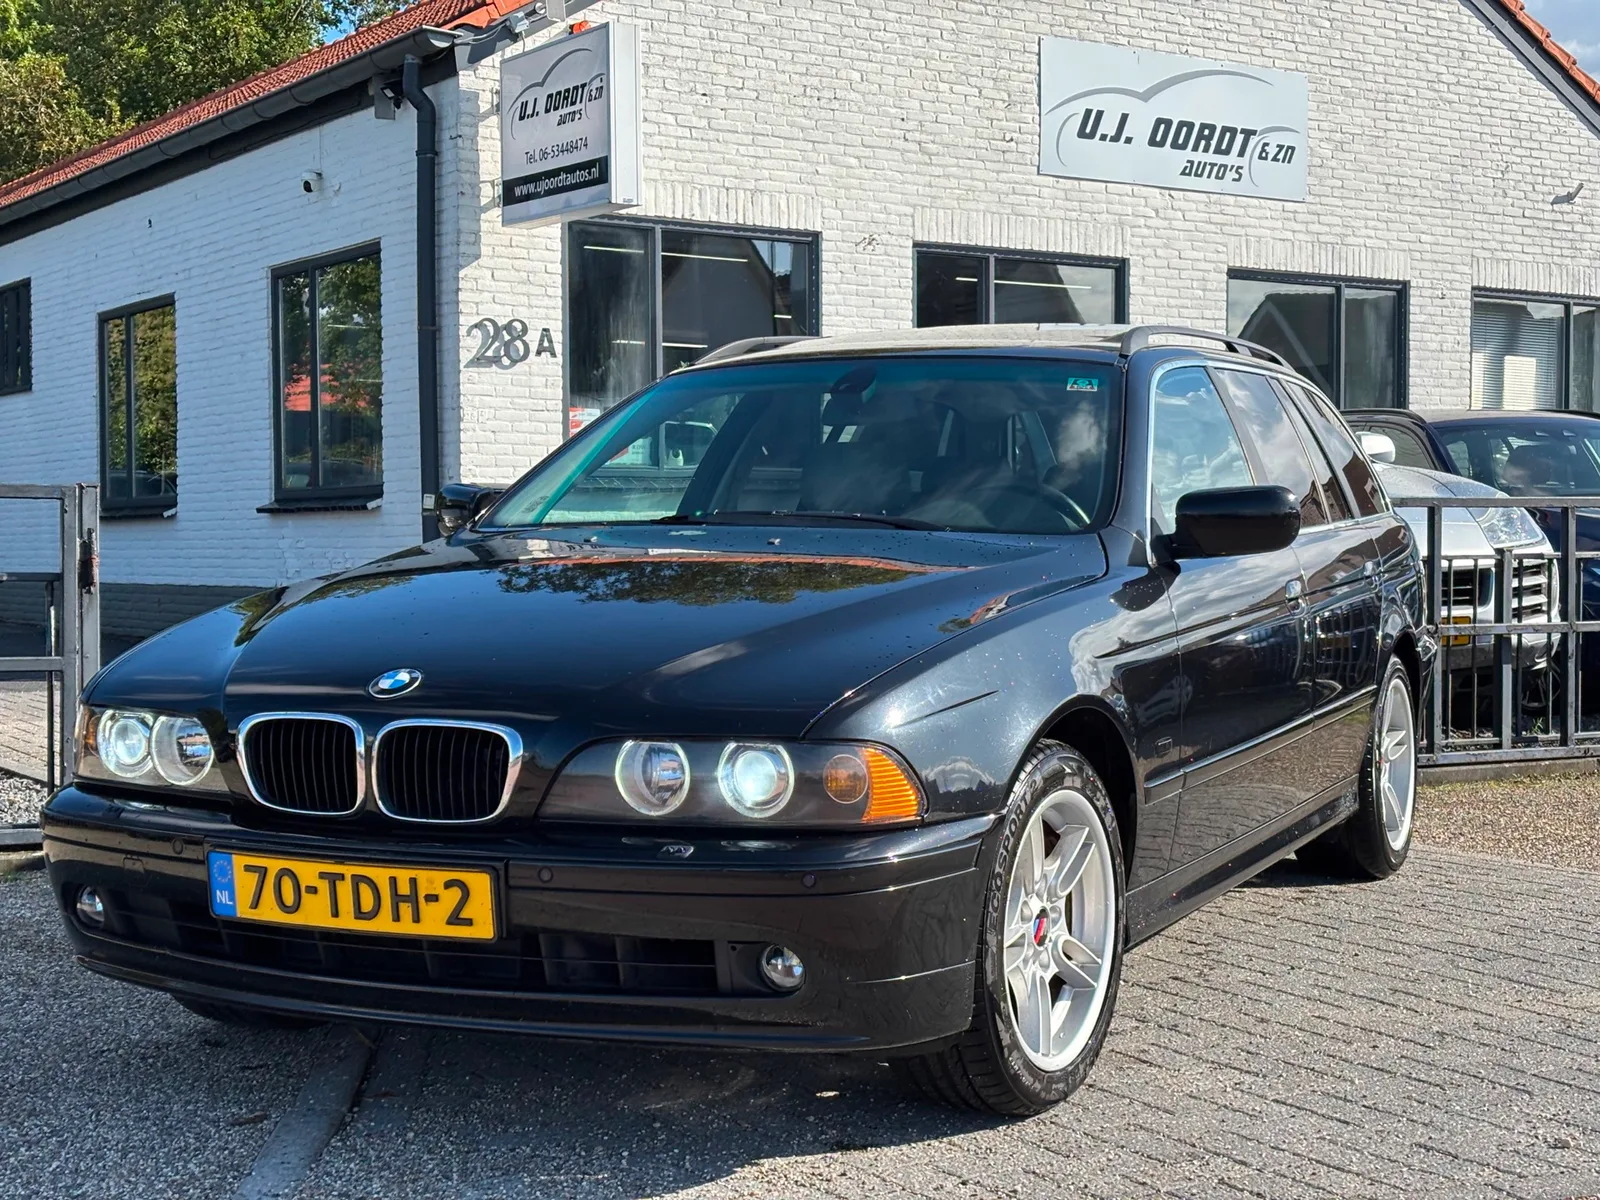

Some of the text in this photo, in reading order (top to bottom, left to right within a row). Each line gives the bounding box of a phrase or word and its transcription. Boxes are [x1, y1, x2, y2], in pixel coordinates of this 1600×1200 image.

[518, 97, 539, 121] U.J.
[544, 82, 588, 114] OORDT
[525, 136, 588, 165] Tel. 06-53448474
[1076, 108, 1134, 145] U.J.
[1147, 117, 1258, 158] OORDT
[1257, 142, 1270, 161] &
[514, 163, 599, 197] www.ujoordtautos.nl
[464, 317, 557, 370] 28 A
[216, 889, 234, 905] NL
[243, 864, 474, 927] 70-TDH-2
